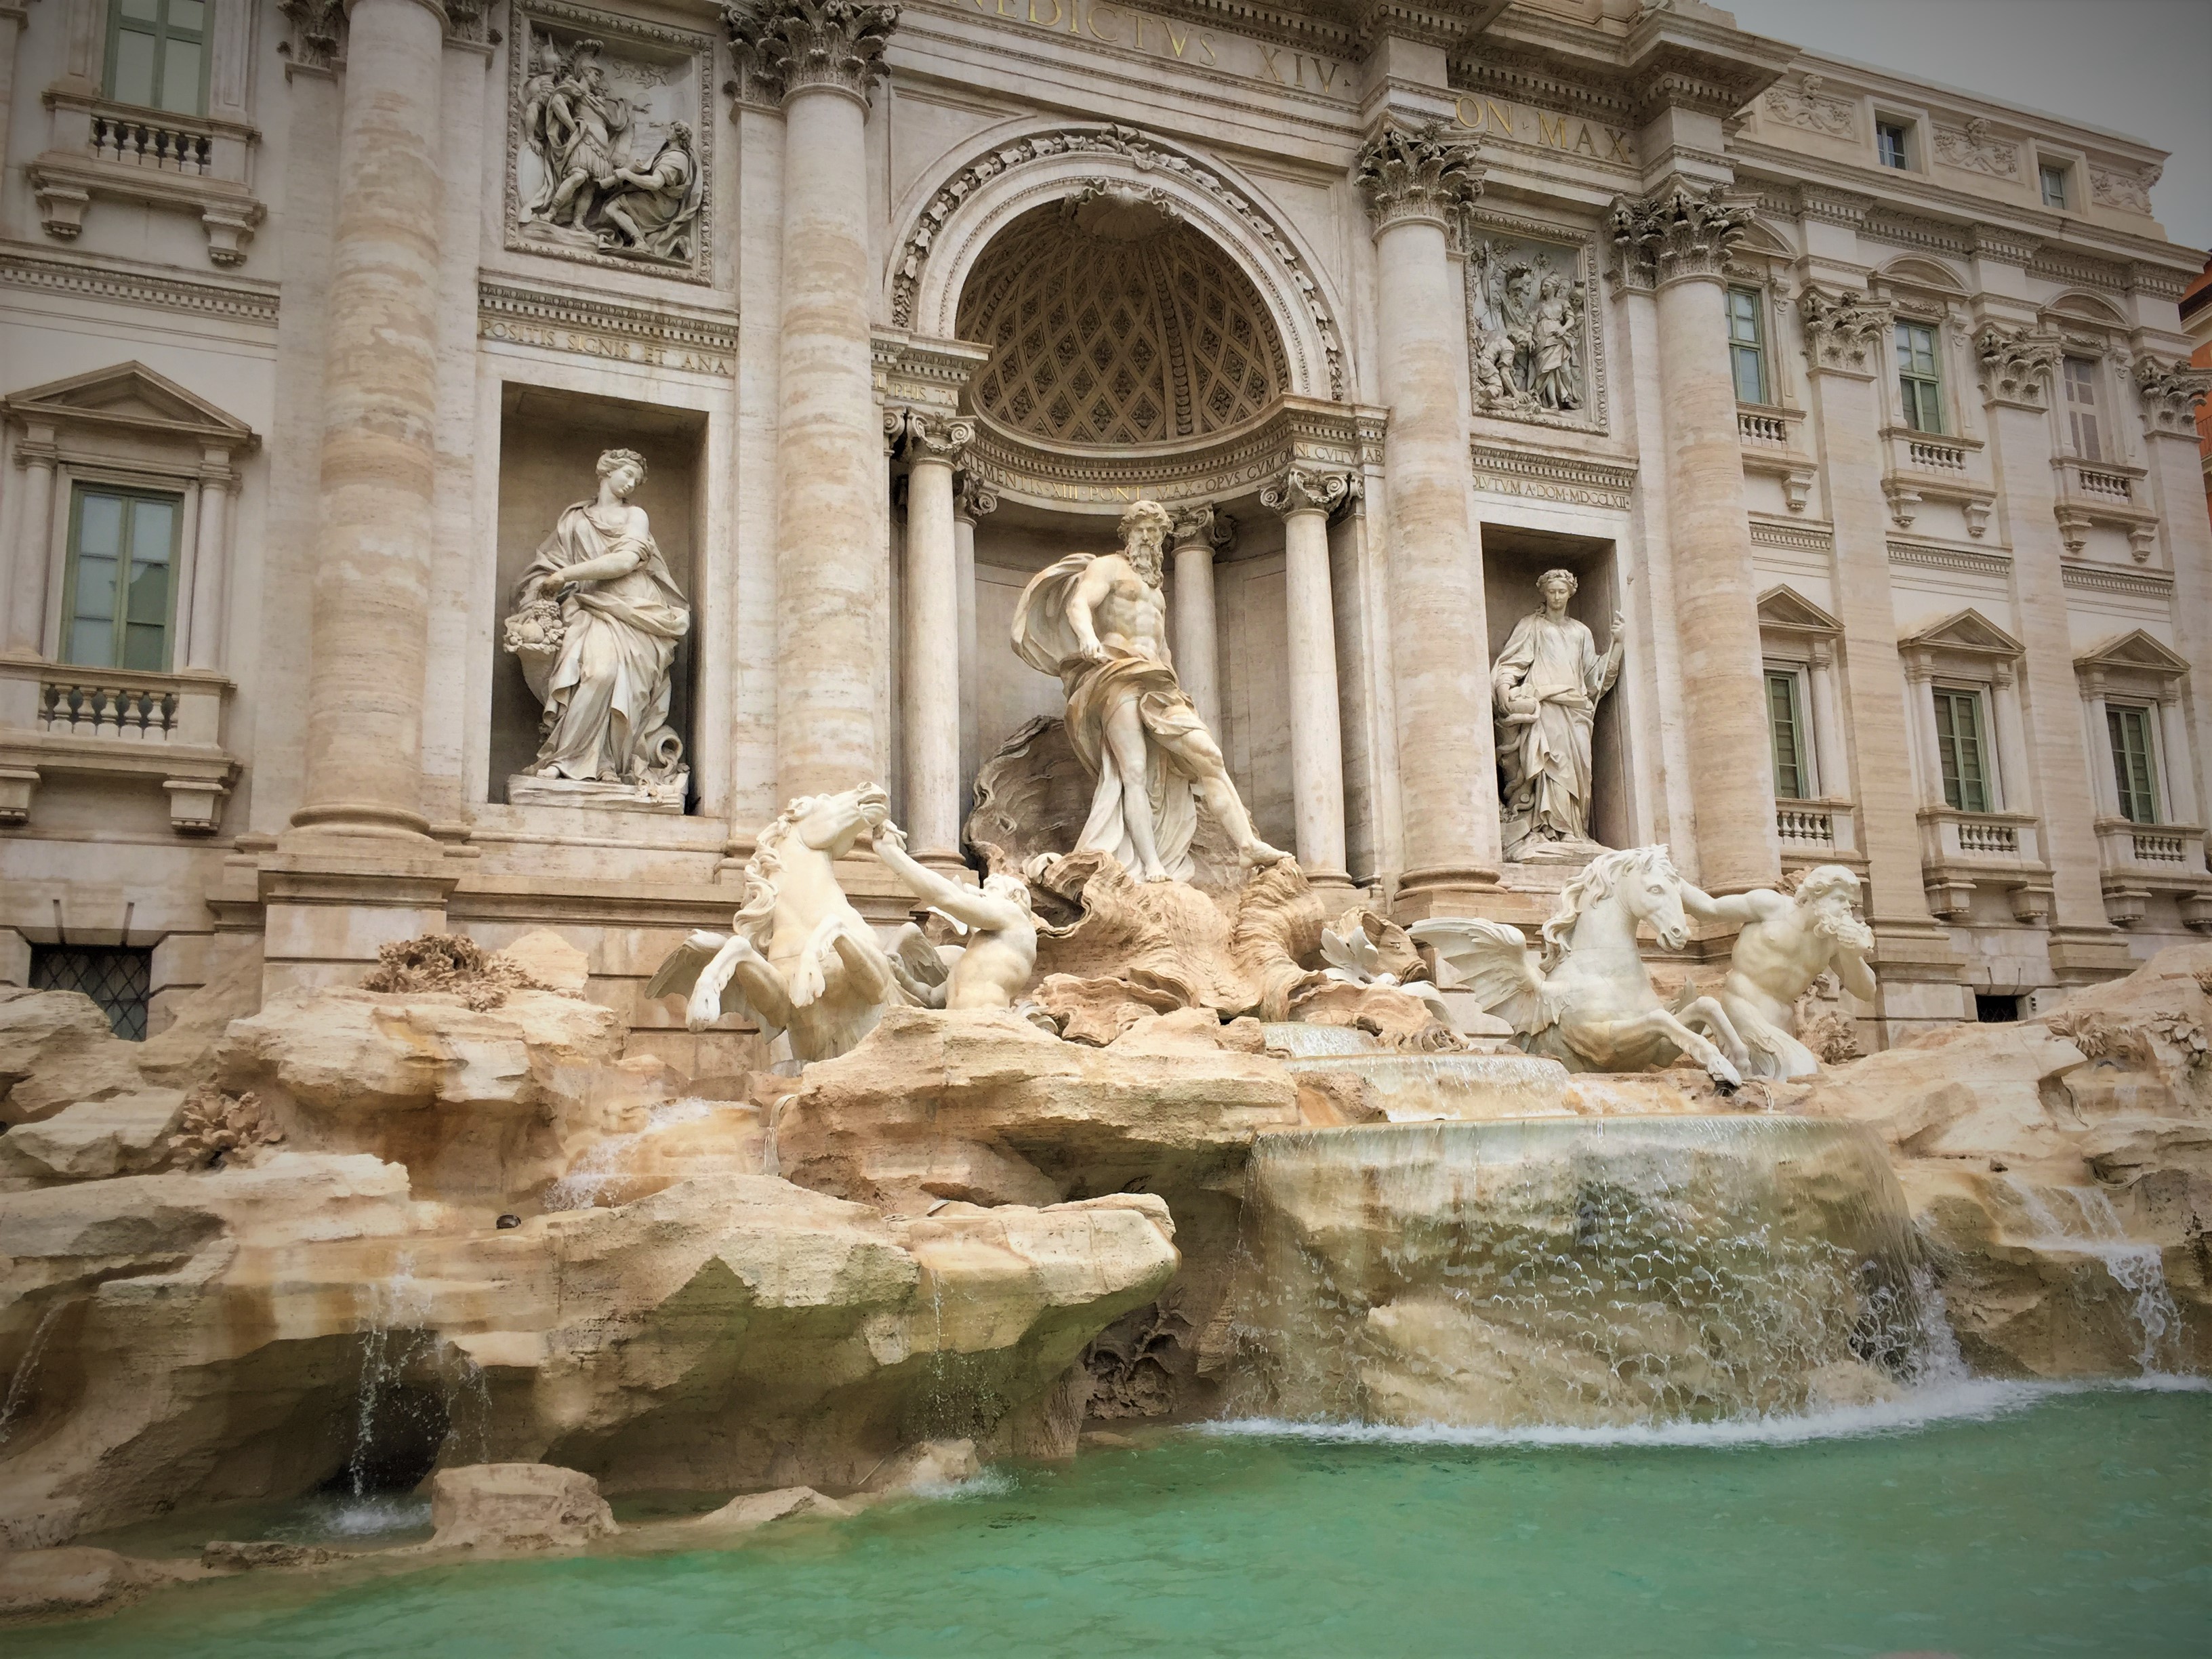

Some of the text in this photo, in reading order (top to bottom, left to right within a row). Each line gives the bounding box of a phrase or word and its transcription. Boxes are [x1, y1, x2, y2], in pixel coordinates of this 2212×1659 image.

[479, 319, 729, 375] POSITIS SIGNIS ET ANA
[962, 450, 1045, 495] CLEMENTIS
[1089, 485, 1144, 501] PONT
[1247, 457, 1275, 479] CVM
